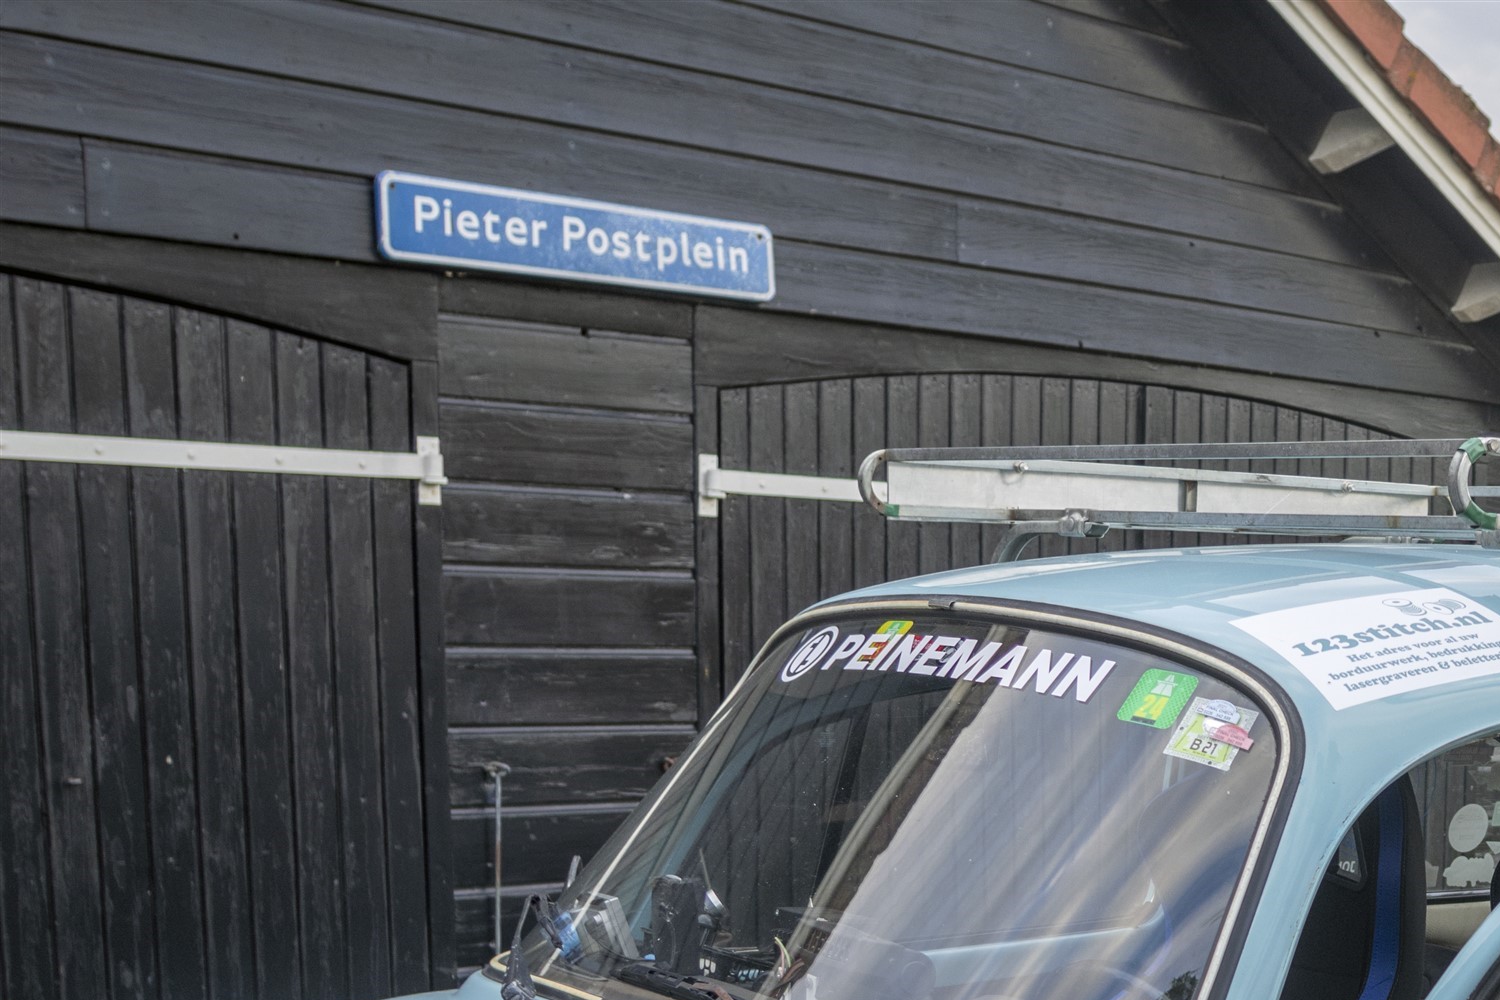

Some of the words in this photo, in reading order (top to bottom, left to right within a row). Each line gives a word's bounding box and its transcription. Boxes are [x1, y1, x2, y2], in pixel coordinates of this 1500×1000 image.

[413, 194, 547, 248] Pieter
[562, 215, 749, 274] Postplein
[1291, 611, 1493, 657] 123stitch.nl
[1347, 650, 1373, 663] Het
[1375, 643, 1411, 657] adres
[1412, 638, 1442, 651] voor
[1444, 634, 1458, 645] al
[1459, 632, 1480, 642] uw
[820, 634, 1116, 703] PEINEMANN
[1328, 653, 1428, 682] borduurwerk,
[1344, 664, 1437, 693] lasergraveren
[1438, 660, 1450, 671] &
[1133, 692, 1170, 721] 24
